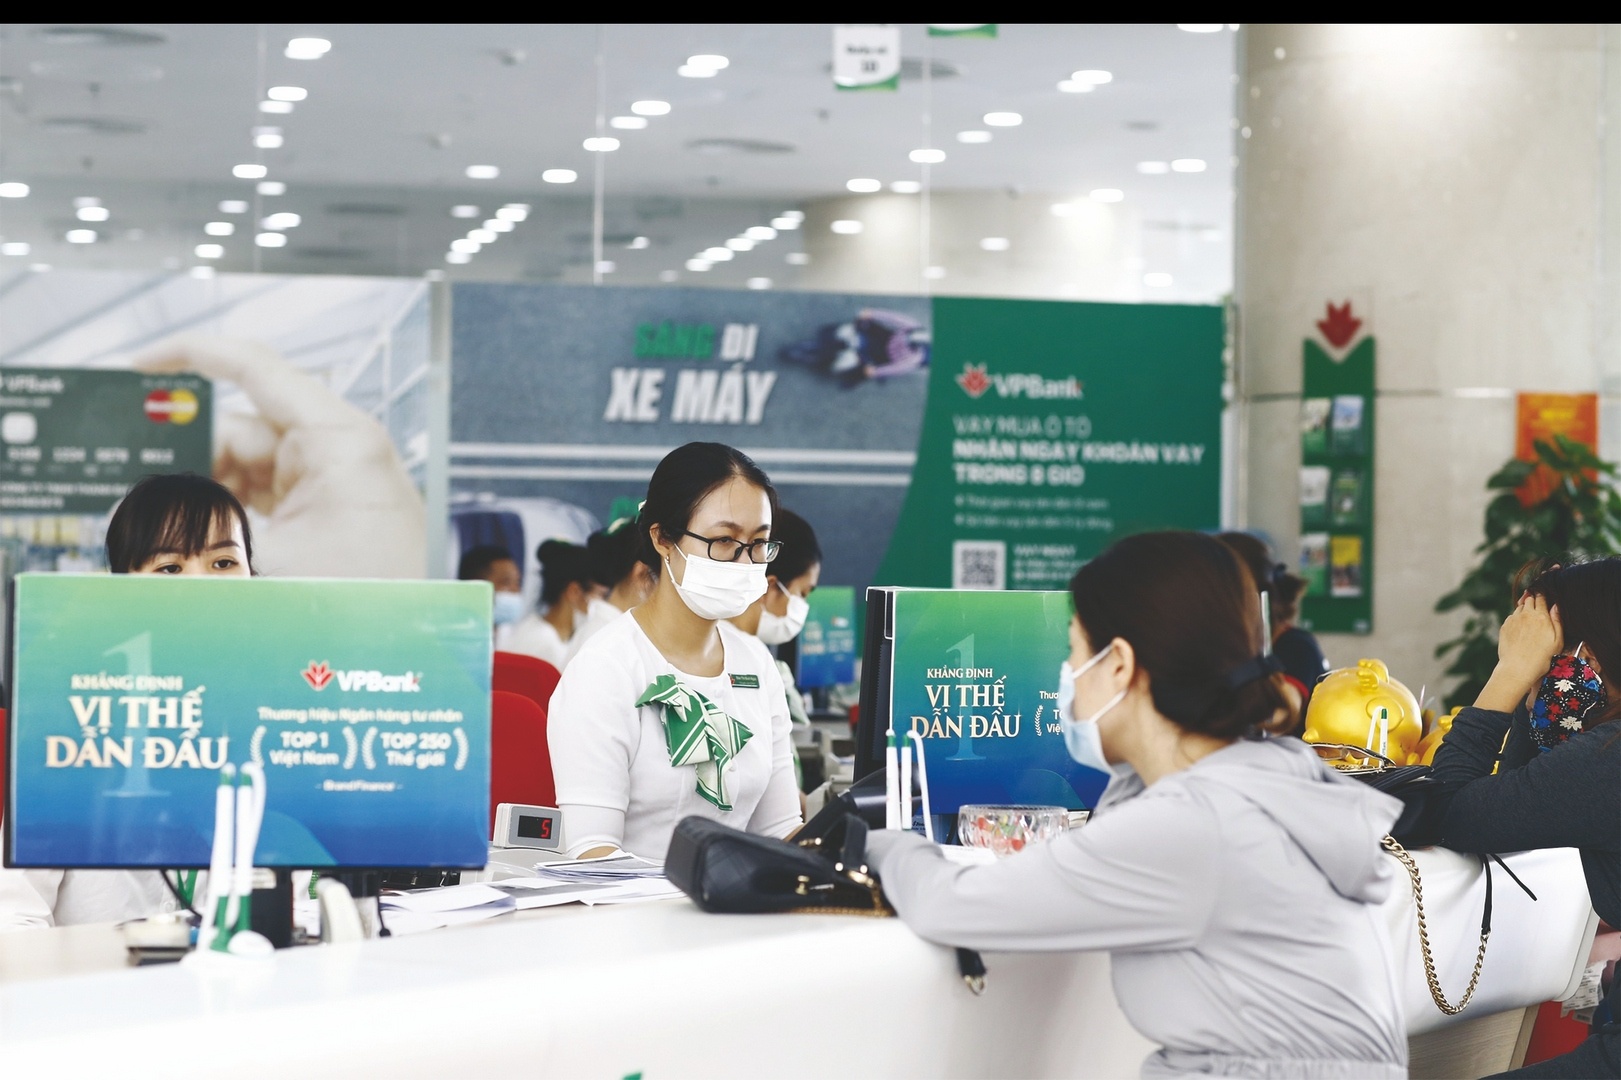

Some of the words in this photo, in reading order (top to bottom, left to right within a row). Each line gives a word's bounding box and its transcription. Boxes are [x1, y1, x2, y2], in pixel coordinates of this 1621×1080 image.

[603, 367, 665, 422] XE
[671, 362, 777, 425] MÁY
[993, 373, 1083, 400] VPBank
[953, 415, 993, 436] VAY
[996, 416, 1042, 437] MUA
[1019, 440, 1080, 462] NGAY
[1162, 443, 1205, 465] VAY
[953, 462, 1028, 485] TRONG
[336, 669, 421, 692] VPBank
[966, 668, 993, 680] ĐỊNH
[925, 684, 951, 713] VỊ
[955, 675, 1007, 707] THẾ
[69, 695, 112, 735] VỊ
[118, 685, 206, 728] THẾ
[910, 708, 964, 739] DẪN
[969, 706, 1022, 738] ĐẦU
[46, 726, 134, 768] DẪN
[280, 731, 318, 749] TOP
[319, 731, 330, 748] 1
[380, 732, 417, 749] TOP
[418, 732, 452, 750] 250
[269, 750, 302, 768] Việt
[303, 751, 339, 766] Nam
[385, 750, 416, 766] Thế
[416, 751, 446, 770] giới
[541, 819, 551, 838] 5
